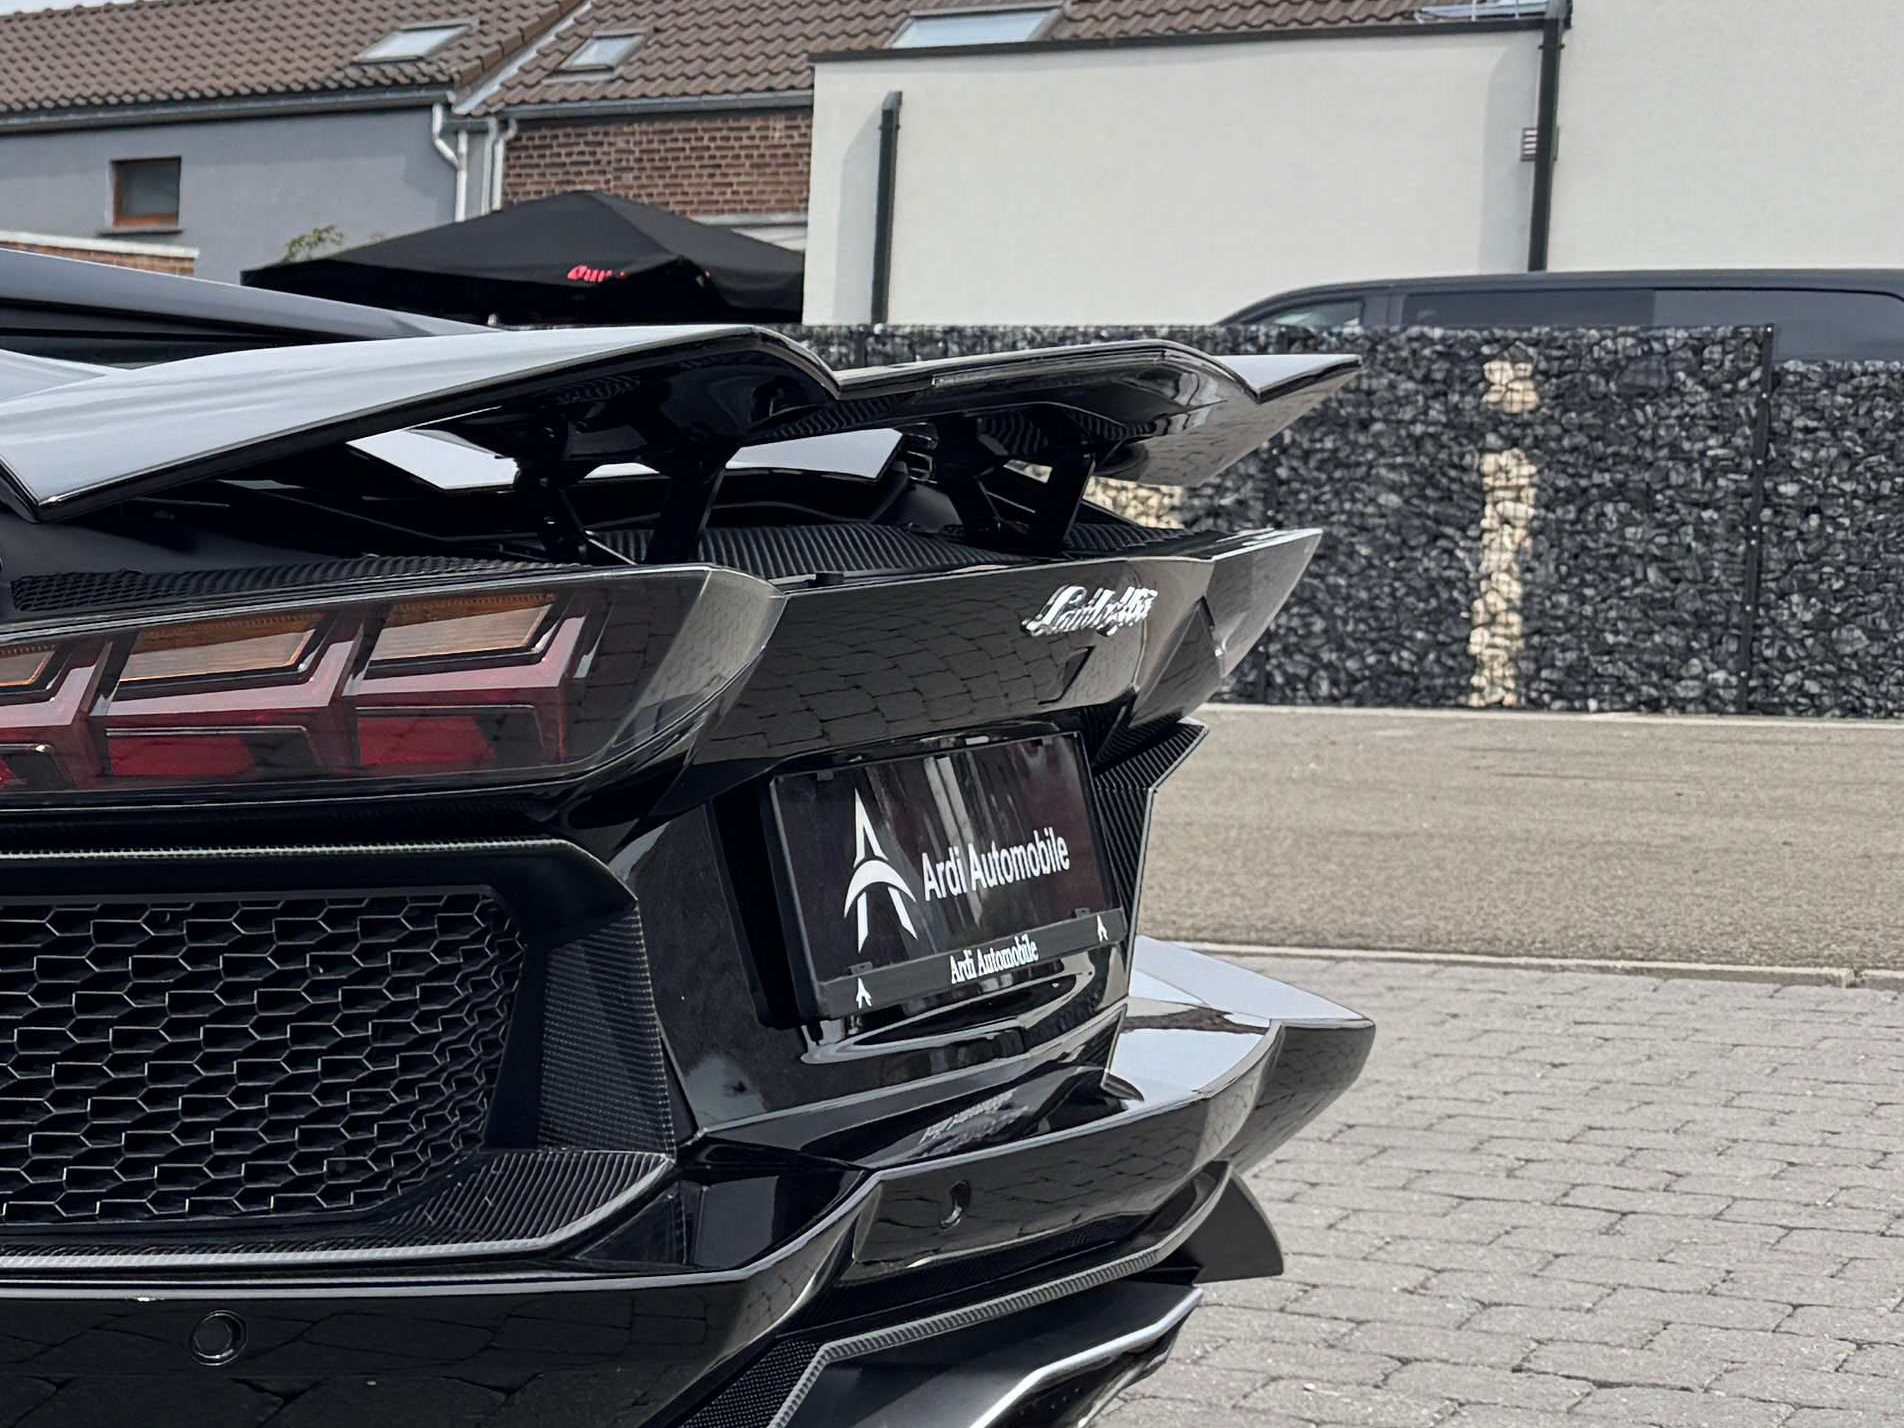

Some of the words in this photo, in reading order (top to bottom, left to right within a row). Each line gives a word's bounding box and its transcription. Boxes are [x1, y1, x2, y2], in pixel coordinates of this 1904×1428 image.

[922, 845, 967, 902] Ardi
[967, 826, 1070, 892] Automobile
[949, 948, 976, 984] Ardi
[977, 933, 1039, 976] Automobile
